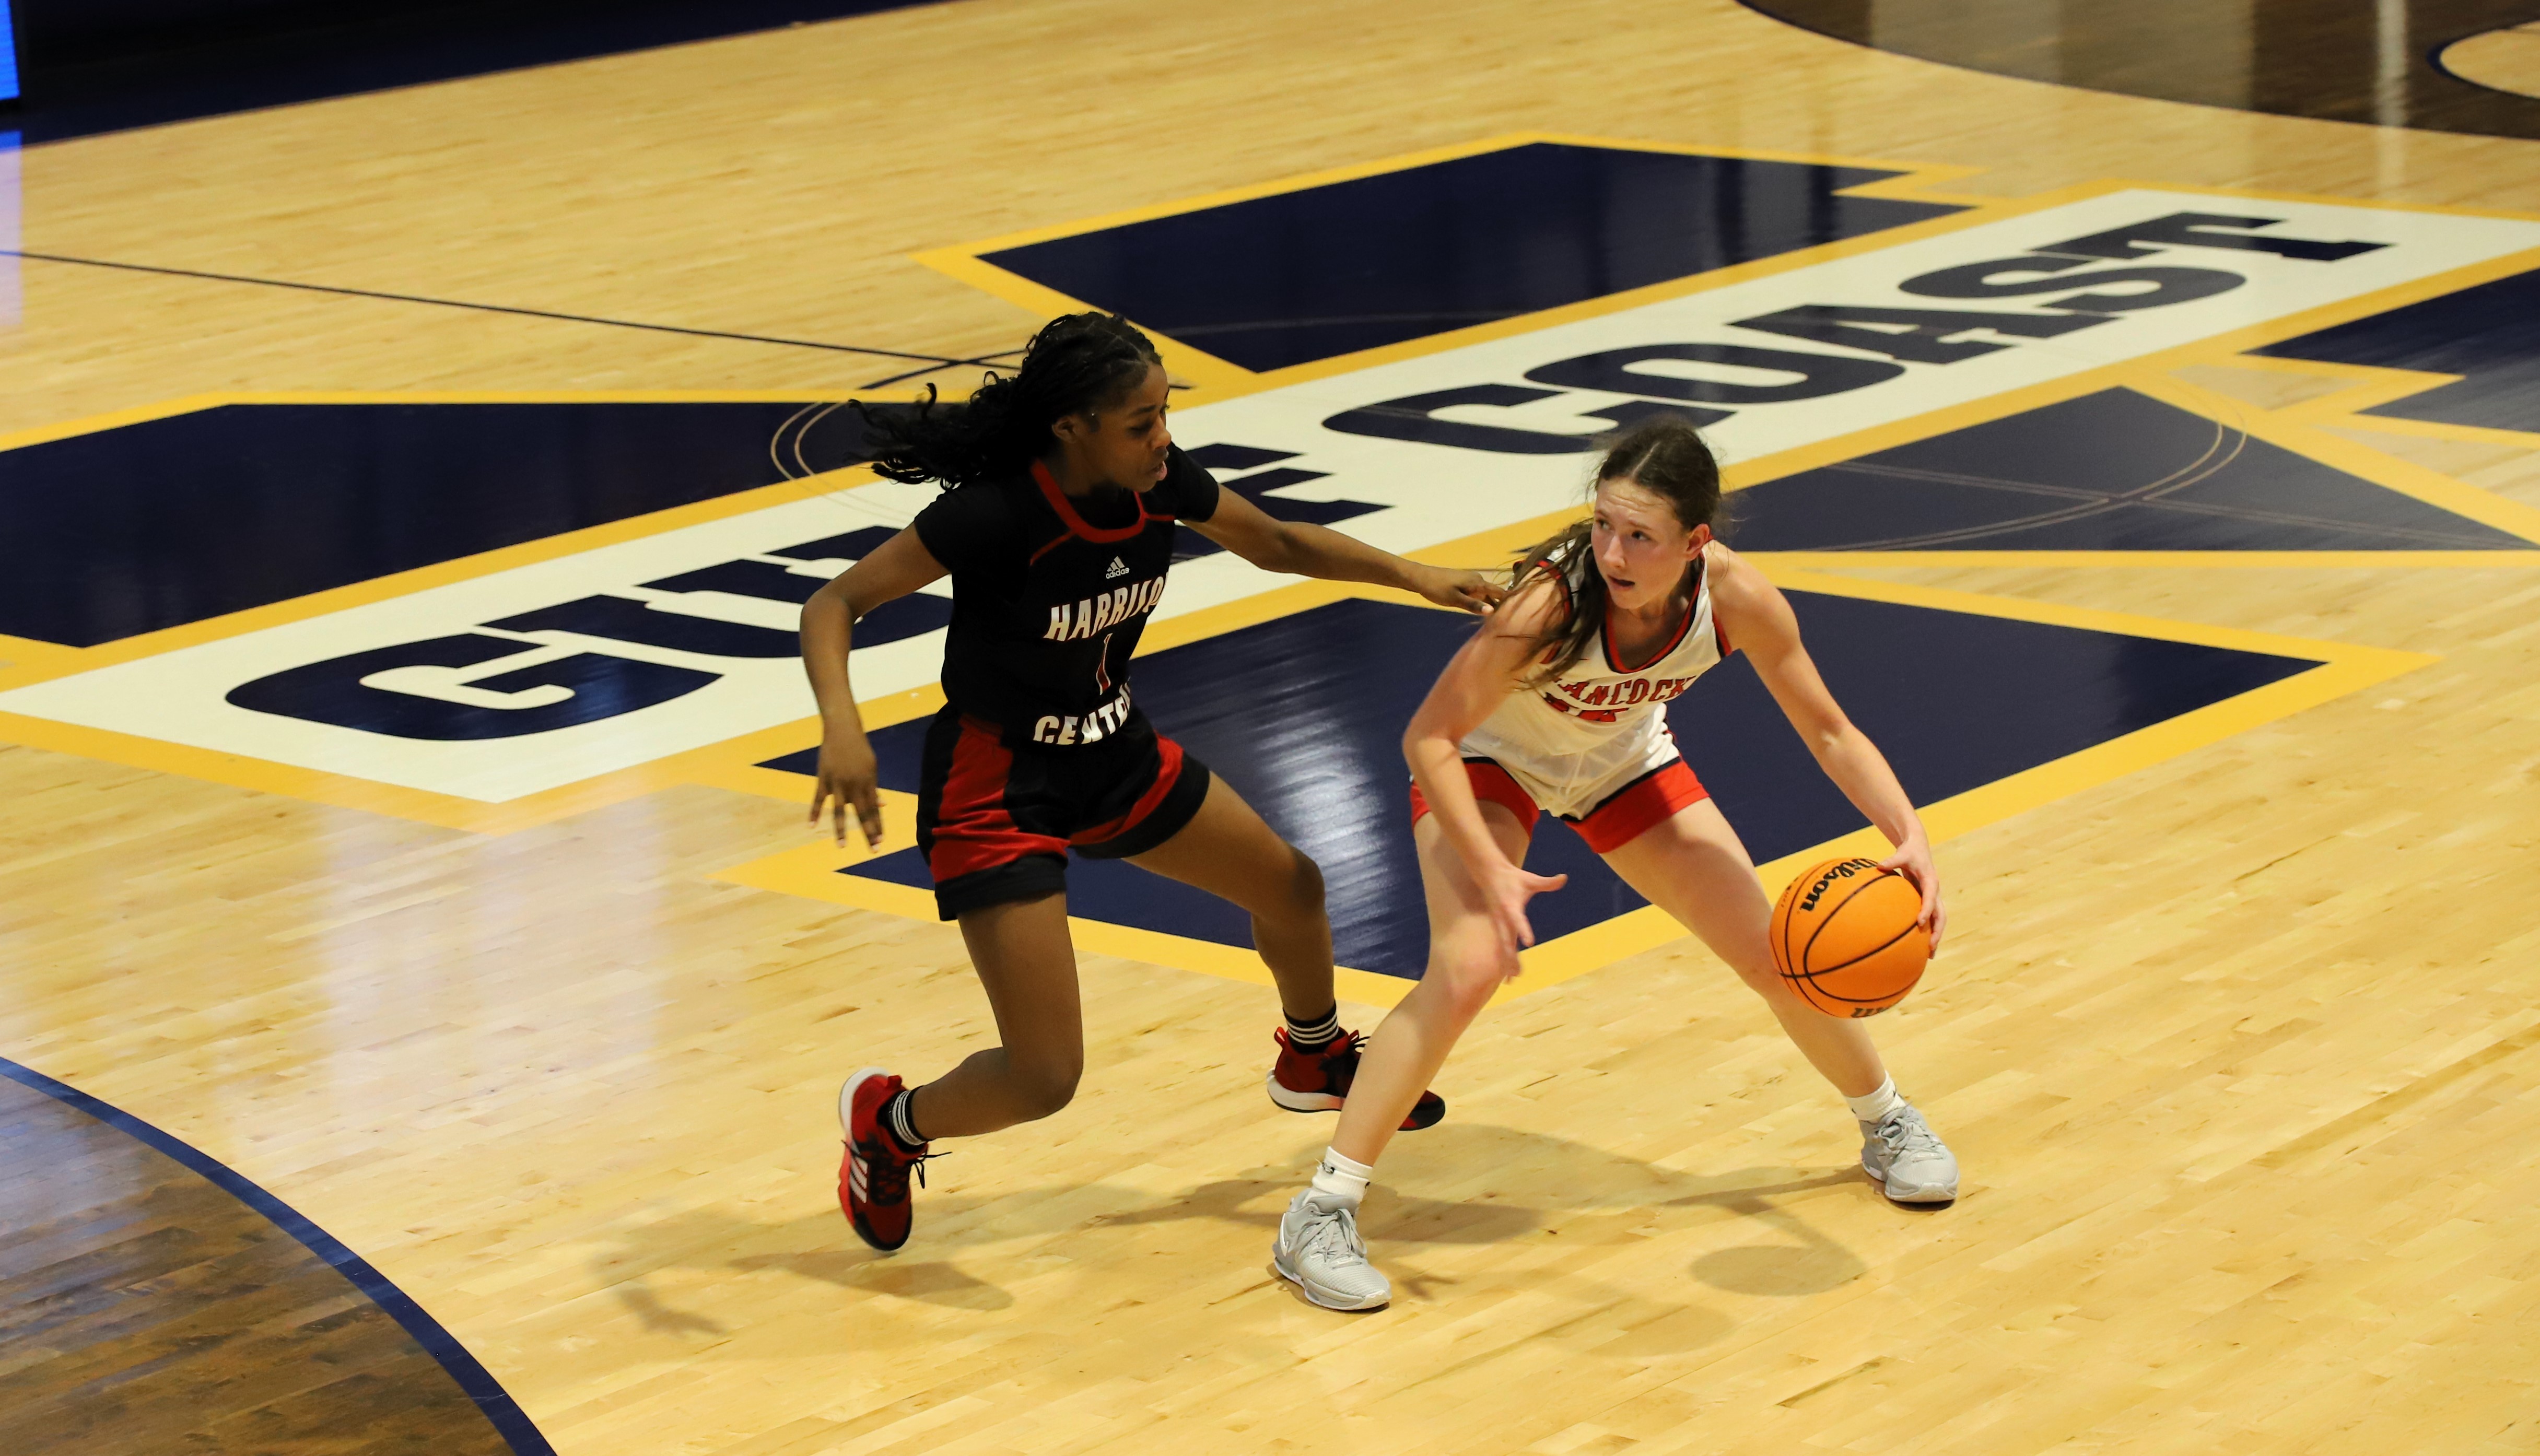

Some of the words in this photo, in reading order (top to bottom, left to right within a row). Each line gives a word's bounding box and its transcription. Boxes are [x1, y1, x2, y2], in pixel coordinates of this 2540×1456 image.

[225, 443, 1396, 741] GUF
[1322, 212, 2395, 455] COAST
[1105, 567, 1130, 579] adidas
[1553, 675, 1697, 706] ANCOCK
